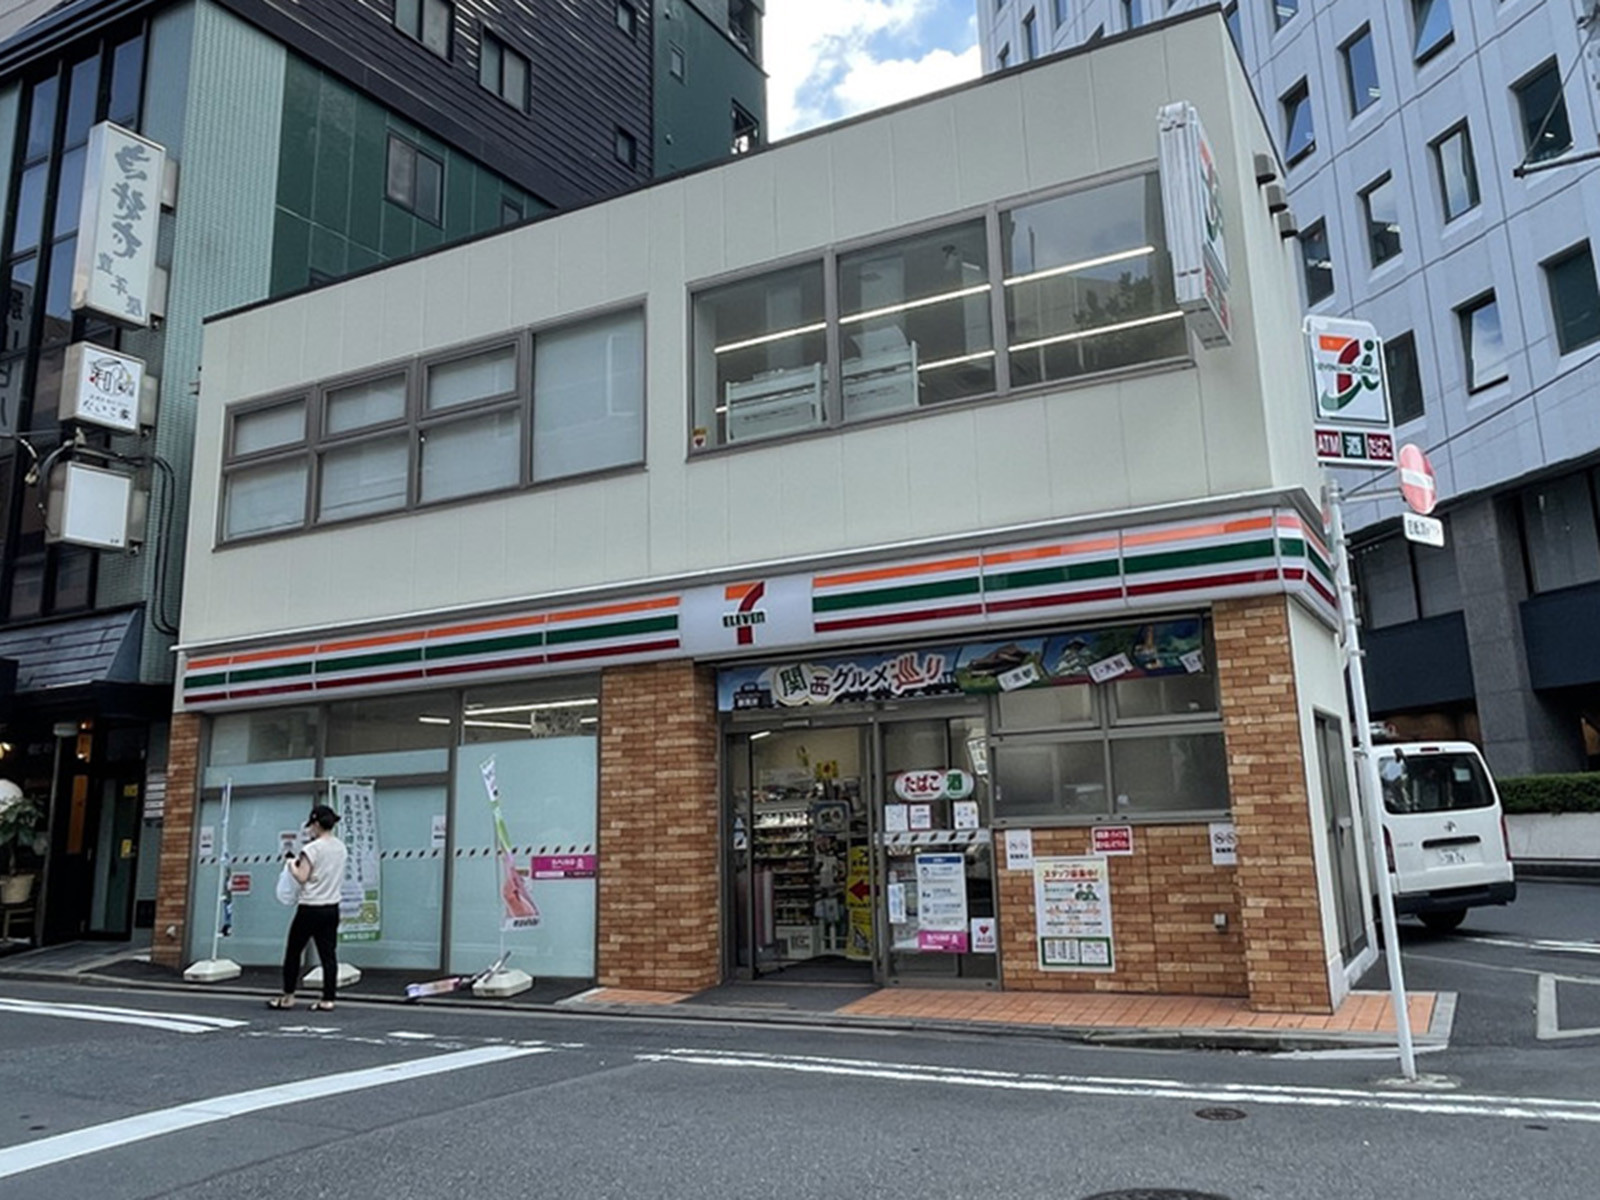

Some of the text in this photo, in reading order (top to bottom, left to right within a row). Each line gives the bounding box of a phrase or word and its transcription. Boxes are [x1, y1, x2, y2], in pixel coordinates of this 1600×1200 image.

[1318, 434, 1339, 453] ATM
[904, 775, 940, 792] たばこ
[947, 773, 963, 791] 酒
